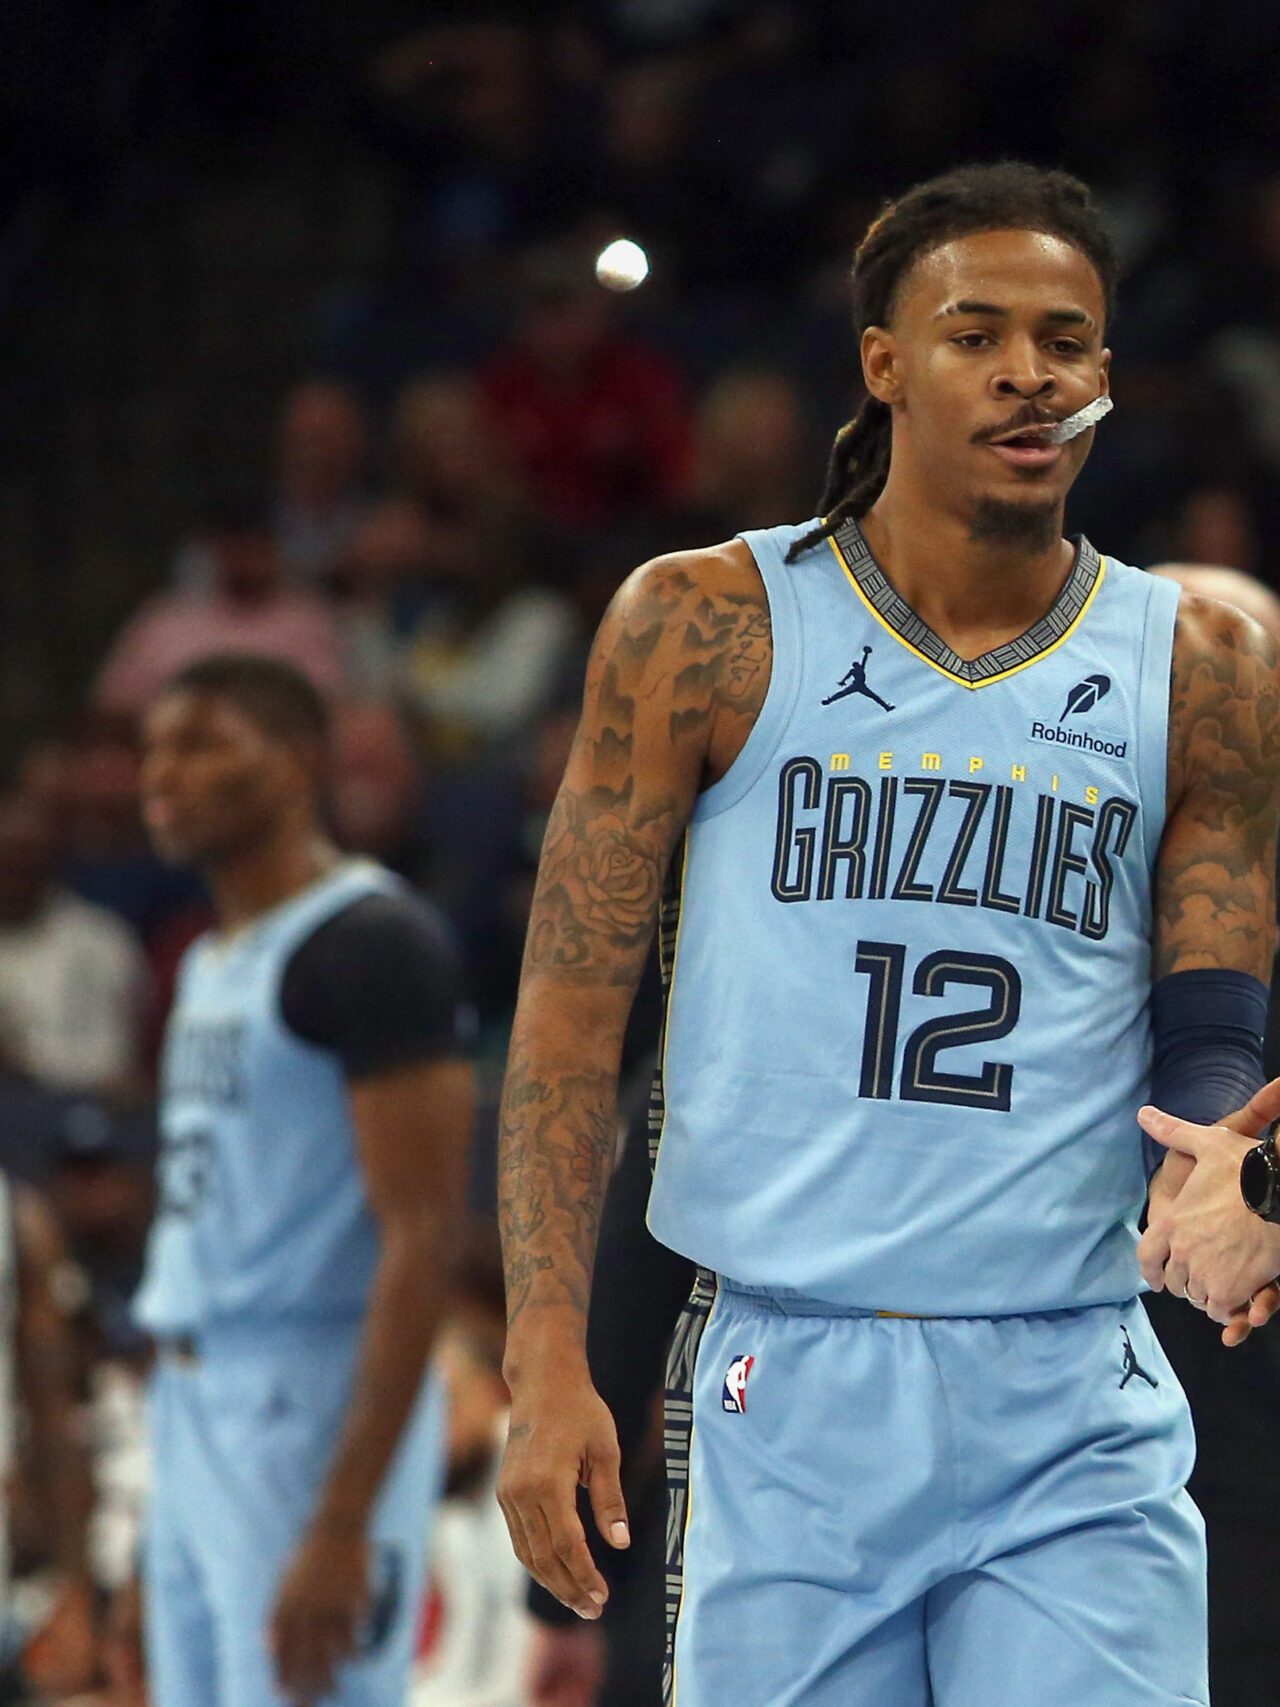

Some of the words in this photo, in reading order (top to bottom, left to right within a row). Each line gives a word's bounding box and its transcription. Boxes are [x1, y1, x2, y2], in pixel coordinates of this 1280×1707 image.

[830, 752, 1099, 804] MEMPHIS
[1031, 721, 1127, 758] Robinhood
[771, 756, 1138, 940] GRIZZLIES
[855, 940, 1022, 1112] 12
